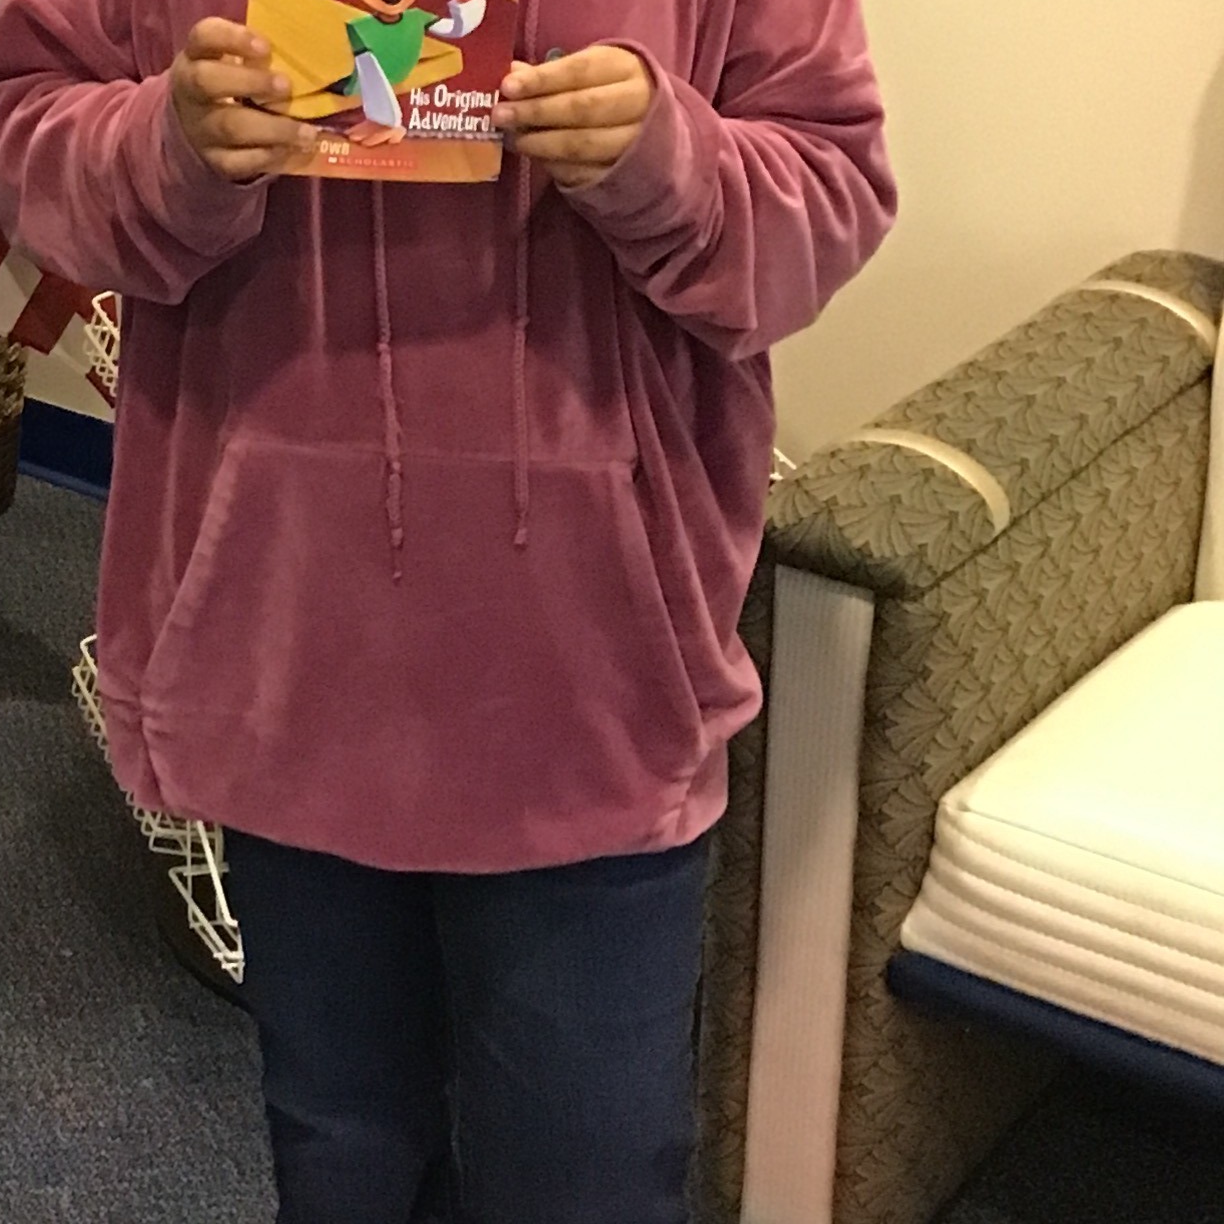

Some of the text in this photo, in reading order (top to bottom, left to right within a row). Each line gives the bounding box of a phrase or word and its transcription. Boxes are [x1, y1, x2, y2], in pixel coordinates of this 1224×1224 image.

[409, 83, 500, 111] His Original
[338, 157, 415, 168] SCHOLASTIC
